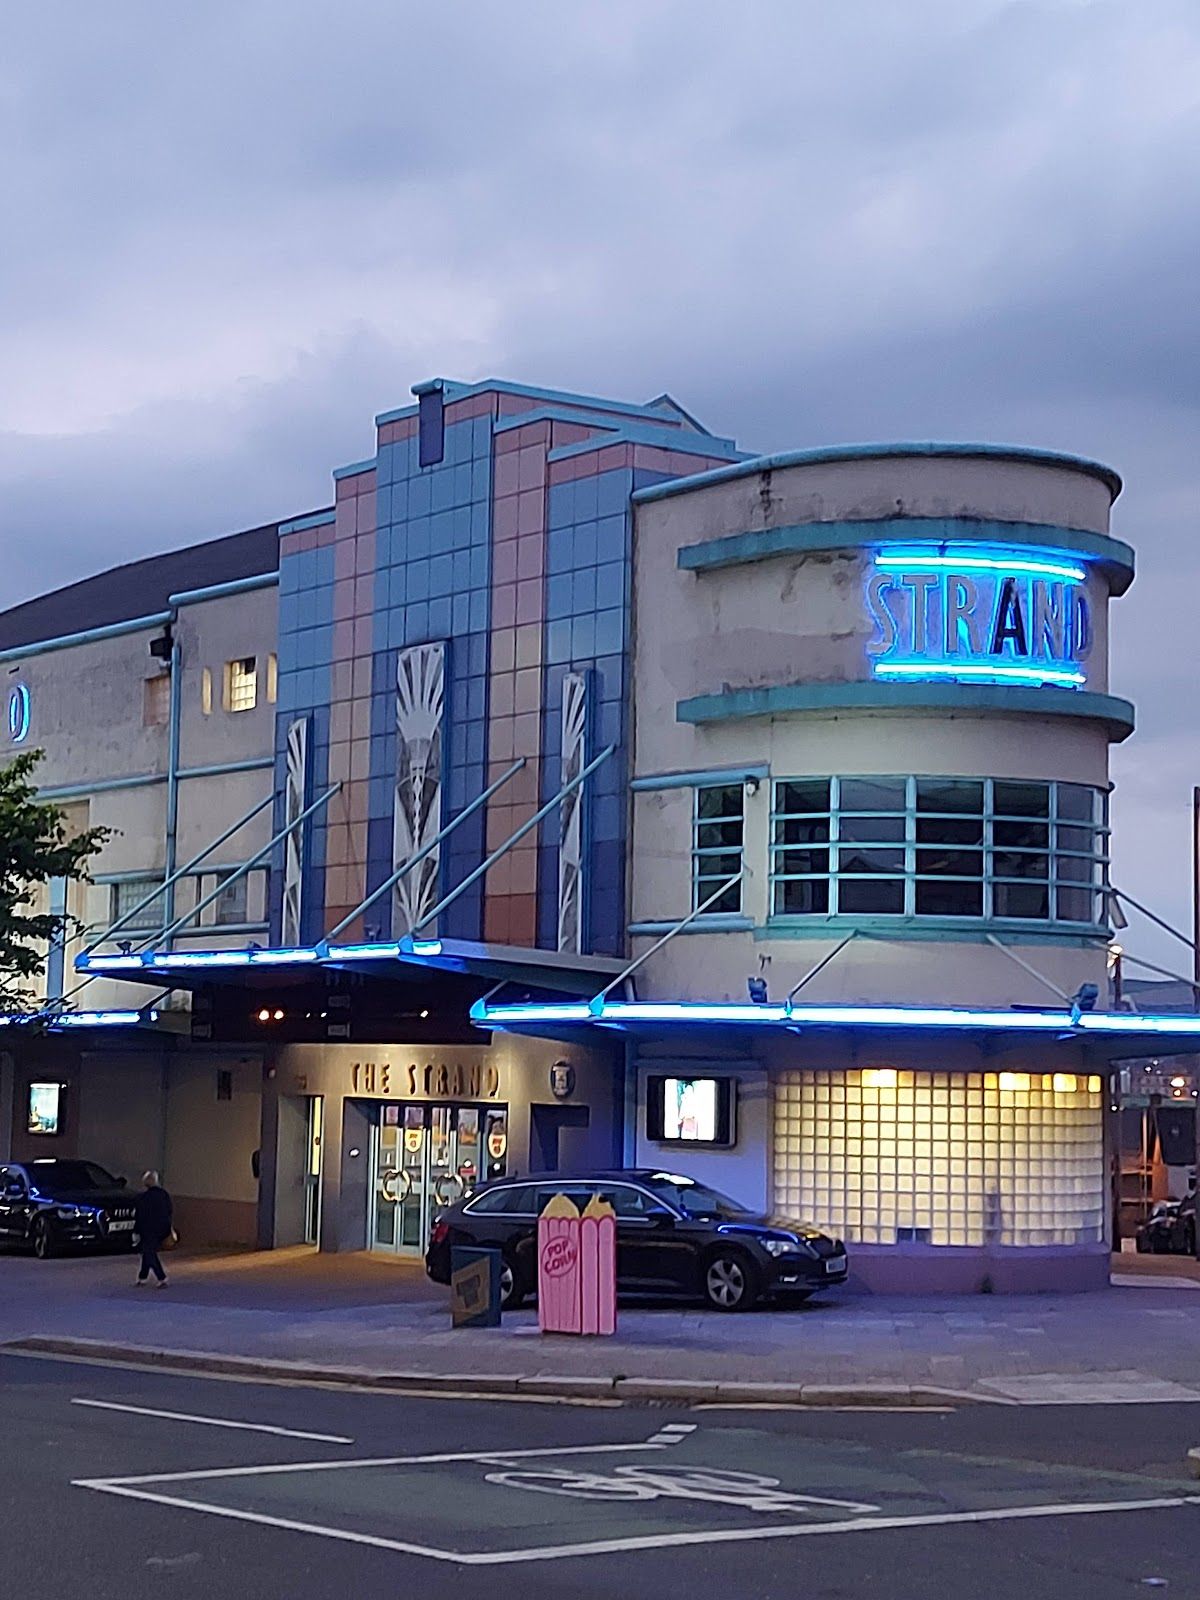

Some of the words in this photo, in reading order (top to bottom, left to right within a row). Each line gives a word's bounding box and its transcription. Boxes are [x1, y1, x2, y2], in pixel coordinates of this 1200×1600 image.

[867, 573, 1091, 664] STRAND
[351, 1063, 390, 1093] THE
[408, 1064, 499, 1097] STRAND
[547, 1240, 569, 1258] POP
